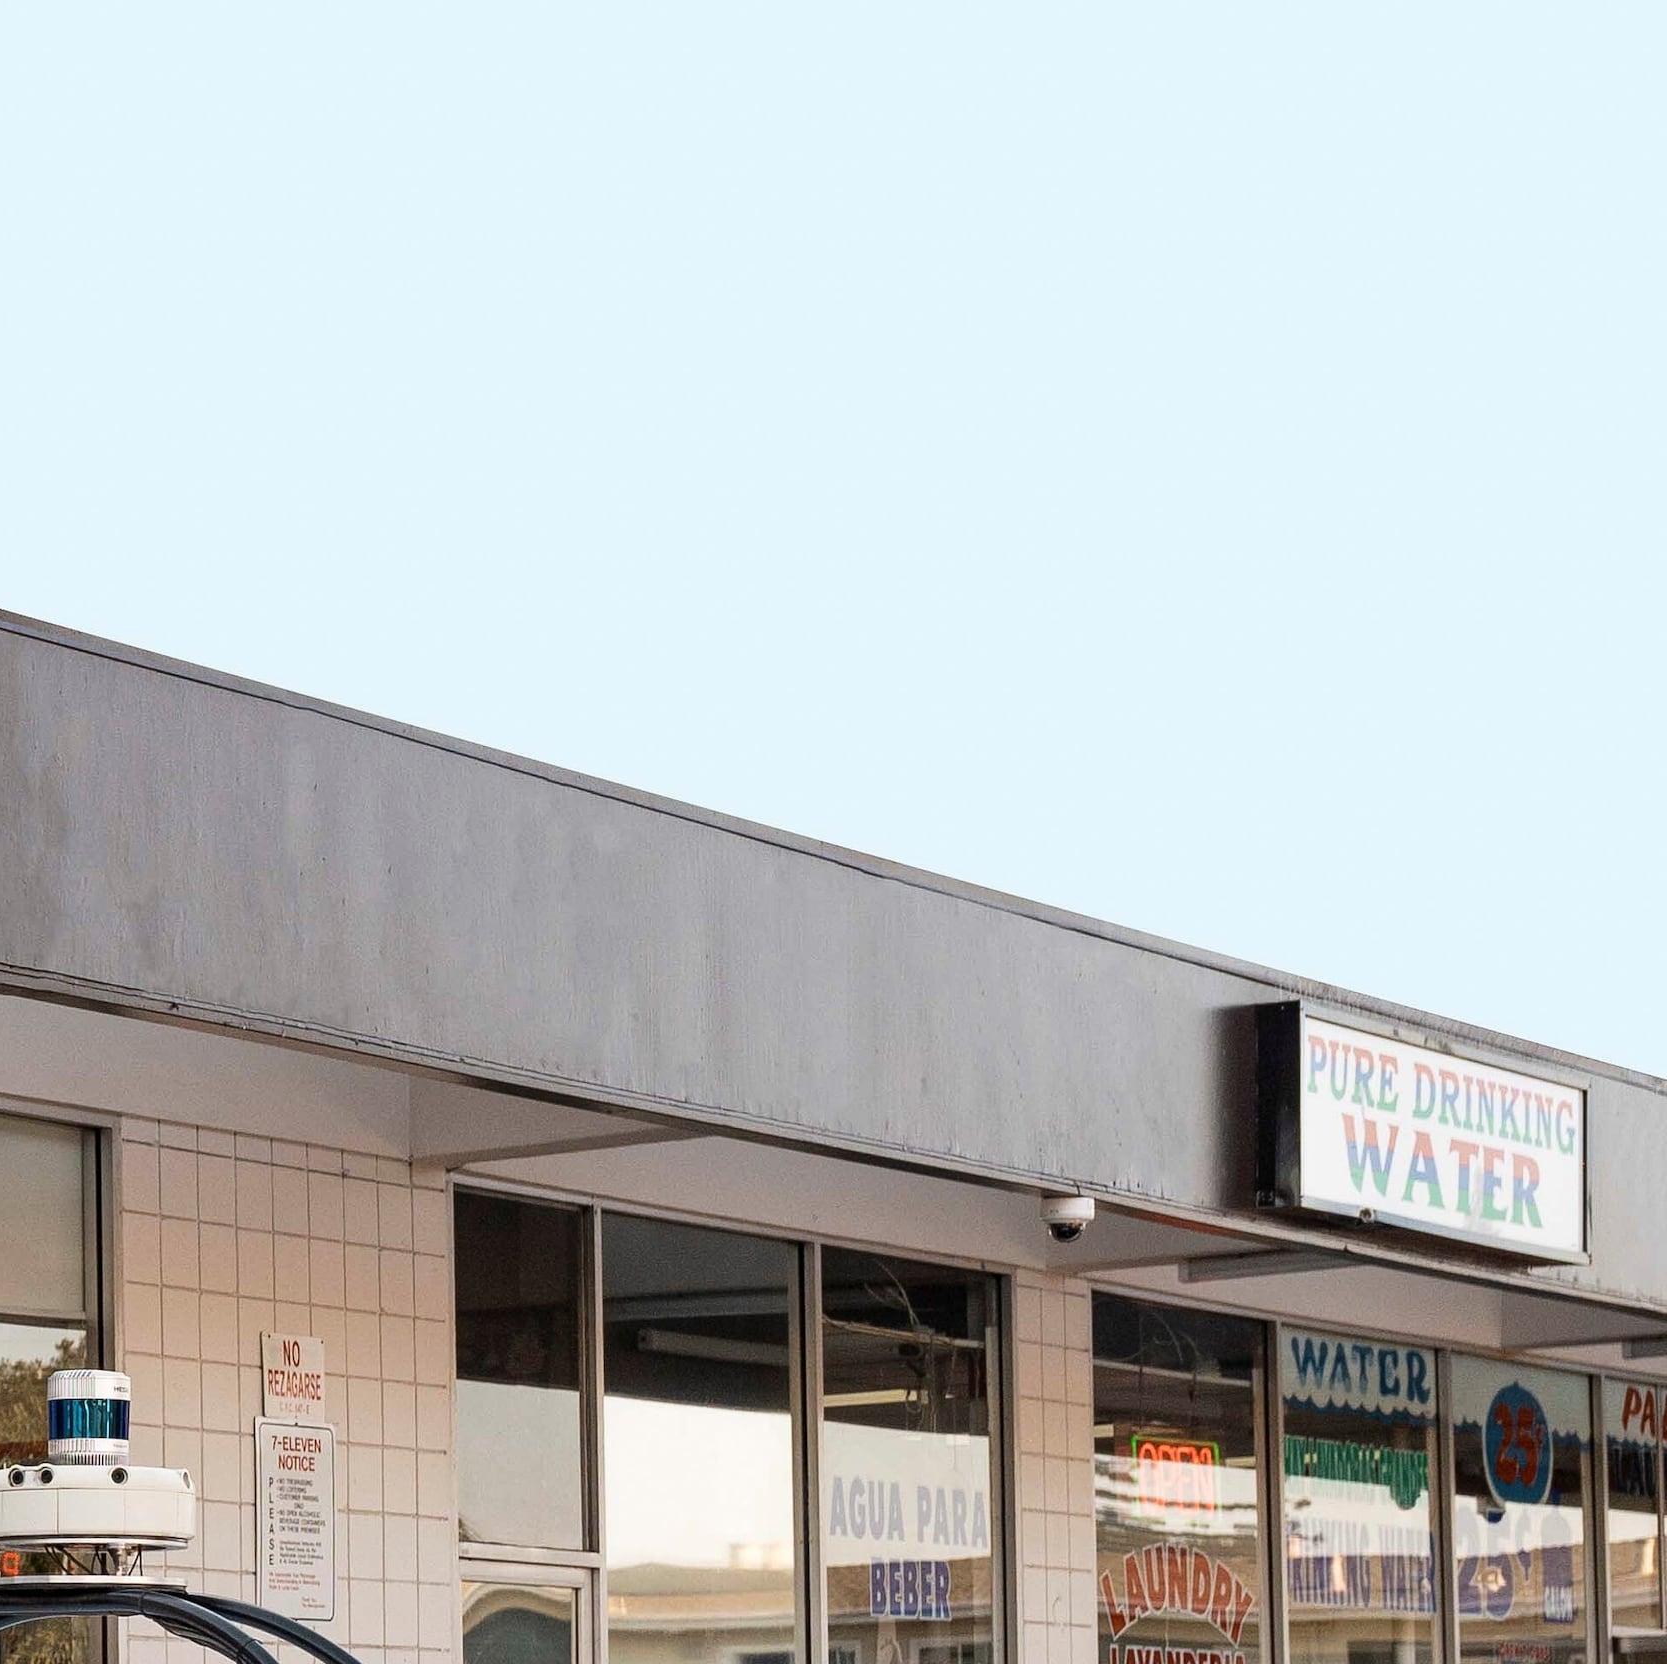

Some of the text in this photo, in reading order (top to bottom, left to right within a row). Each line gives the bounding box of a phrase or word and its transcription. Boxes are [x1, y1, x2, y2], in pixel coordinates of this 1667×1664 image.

[1307, 1034, 1576, 1156] PURE DRINKING
[1341, 1112, 1543, 1229] WATER
[267, 1368, 322, 1401] REZAGARSE
[282, 1340, 301, 1368] NO
[1291, 1336, 1431, 1404] WATER
[271, 1435, 322, 1454] 7-ELEVEN
[278, 1455, 316, 1472] NOTICE
[830, 1476, 987, 1548] AGUA PARA
[1138, 1443, 1215, 1515] OPEN
[870, 1557, 952, 1621] BEBER
[1100, 1542, 1253, 1648] LAUNDRY
